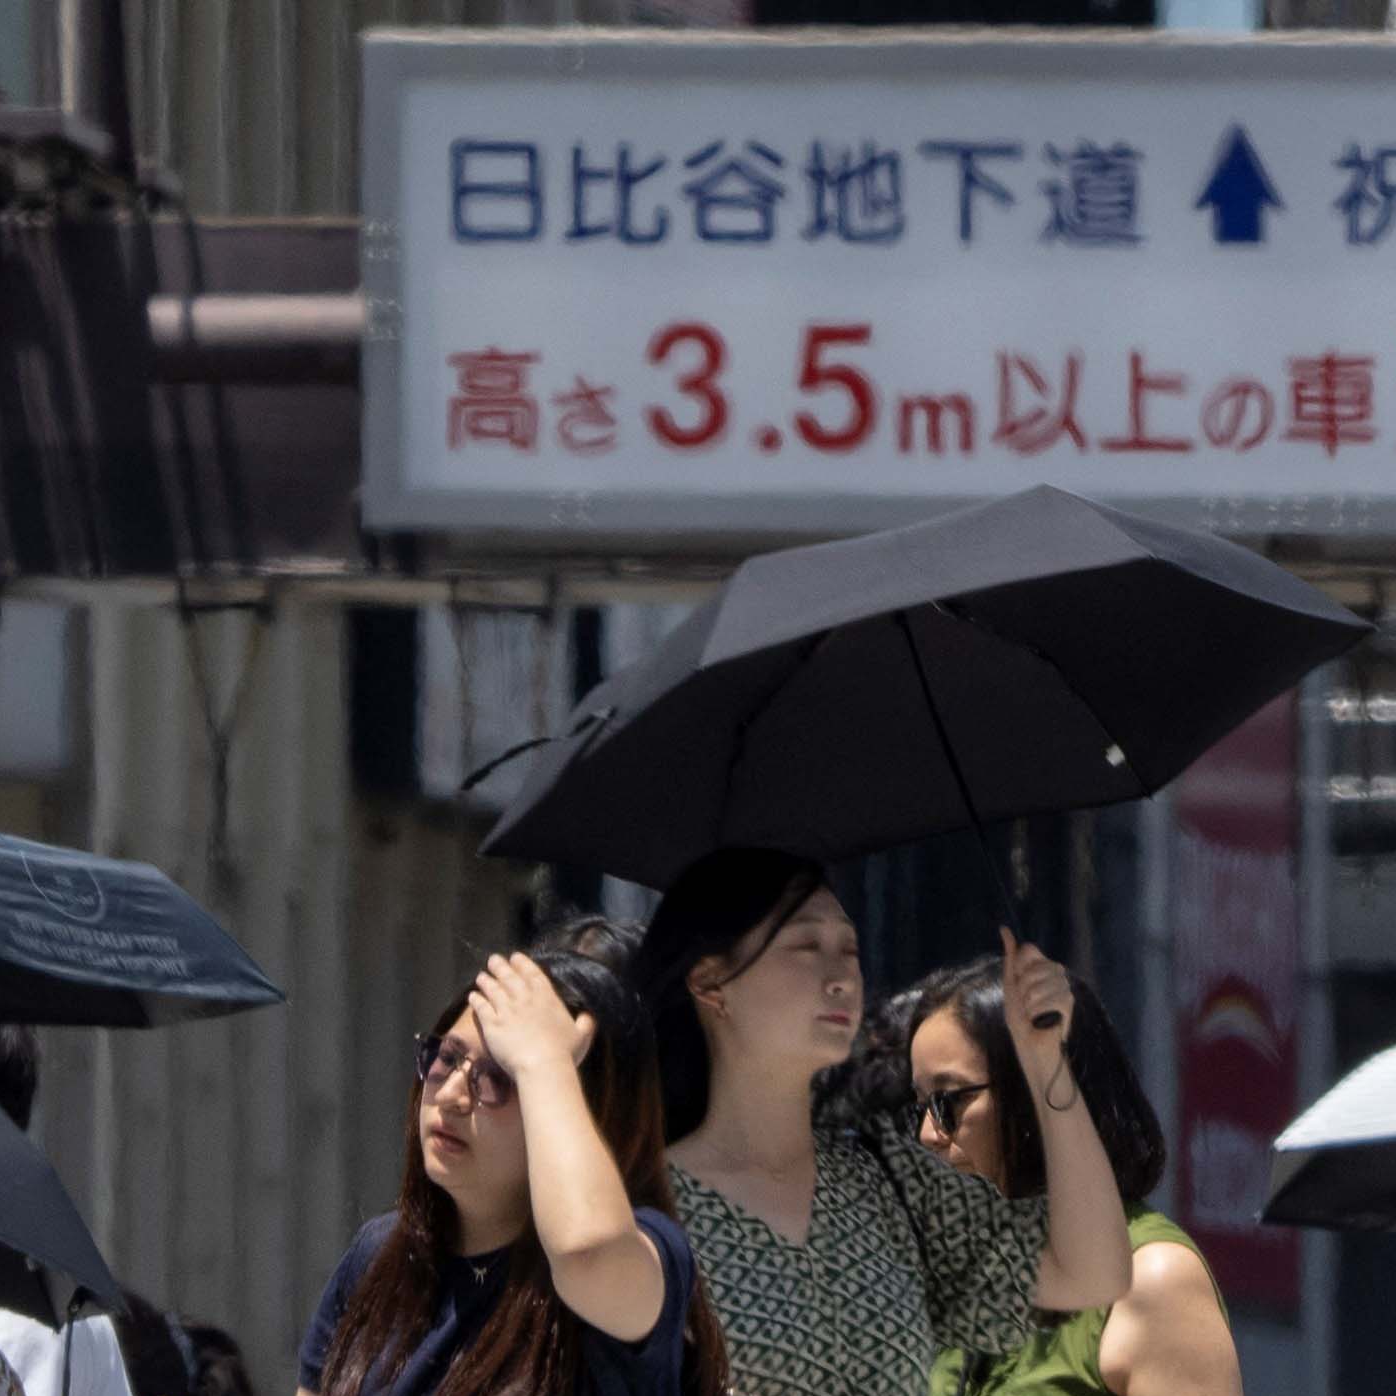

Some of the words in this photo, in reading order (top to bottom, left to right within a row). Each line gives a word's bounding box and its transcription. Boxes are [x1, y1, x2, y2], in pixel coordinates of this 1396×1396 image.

[449, 138, 1146, 247] 日比谷地下道
